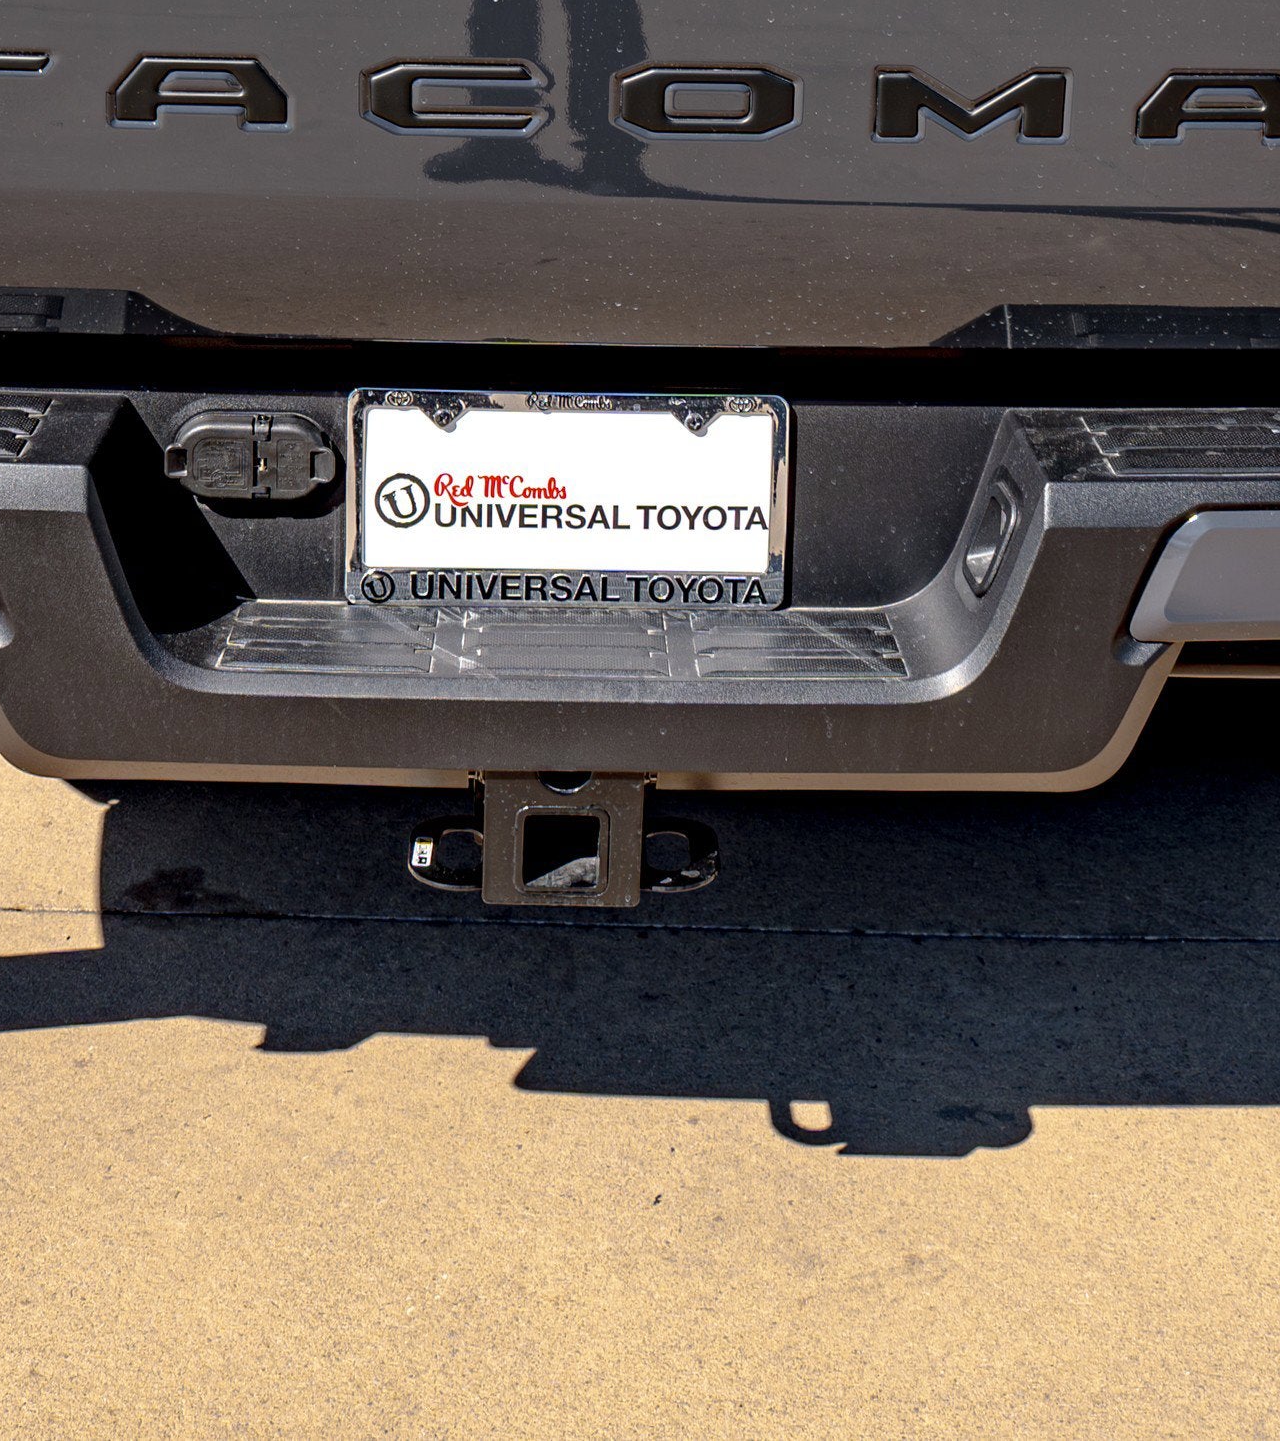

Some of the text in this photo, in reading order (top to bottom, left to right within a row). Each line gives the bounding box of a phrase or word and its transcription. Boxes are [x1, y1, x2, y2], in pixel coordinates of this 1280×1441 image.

[434, 472, 567, 507] Red McCombs
[434, 503, 769, 531] UNIVERSAL TOYOTA
[409, 572, 768, 605] UNIVERSAL TOYOTA
